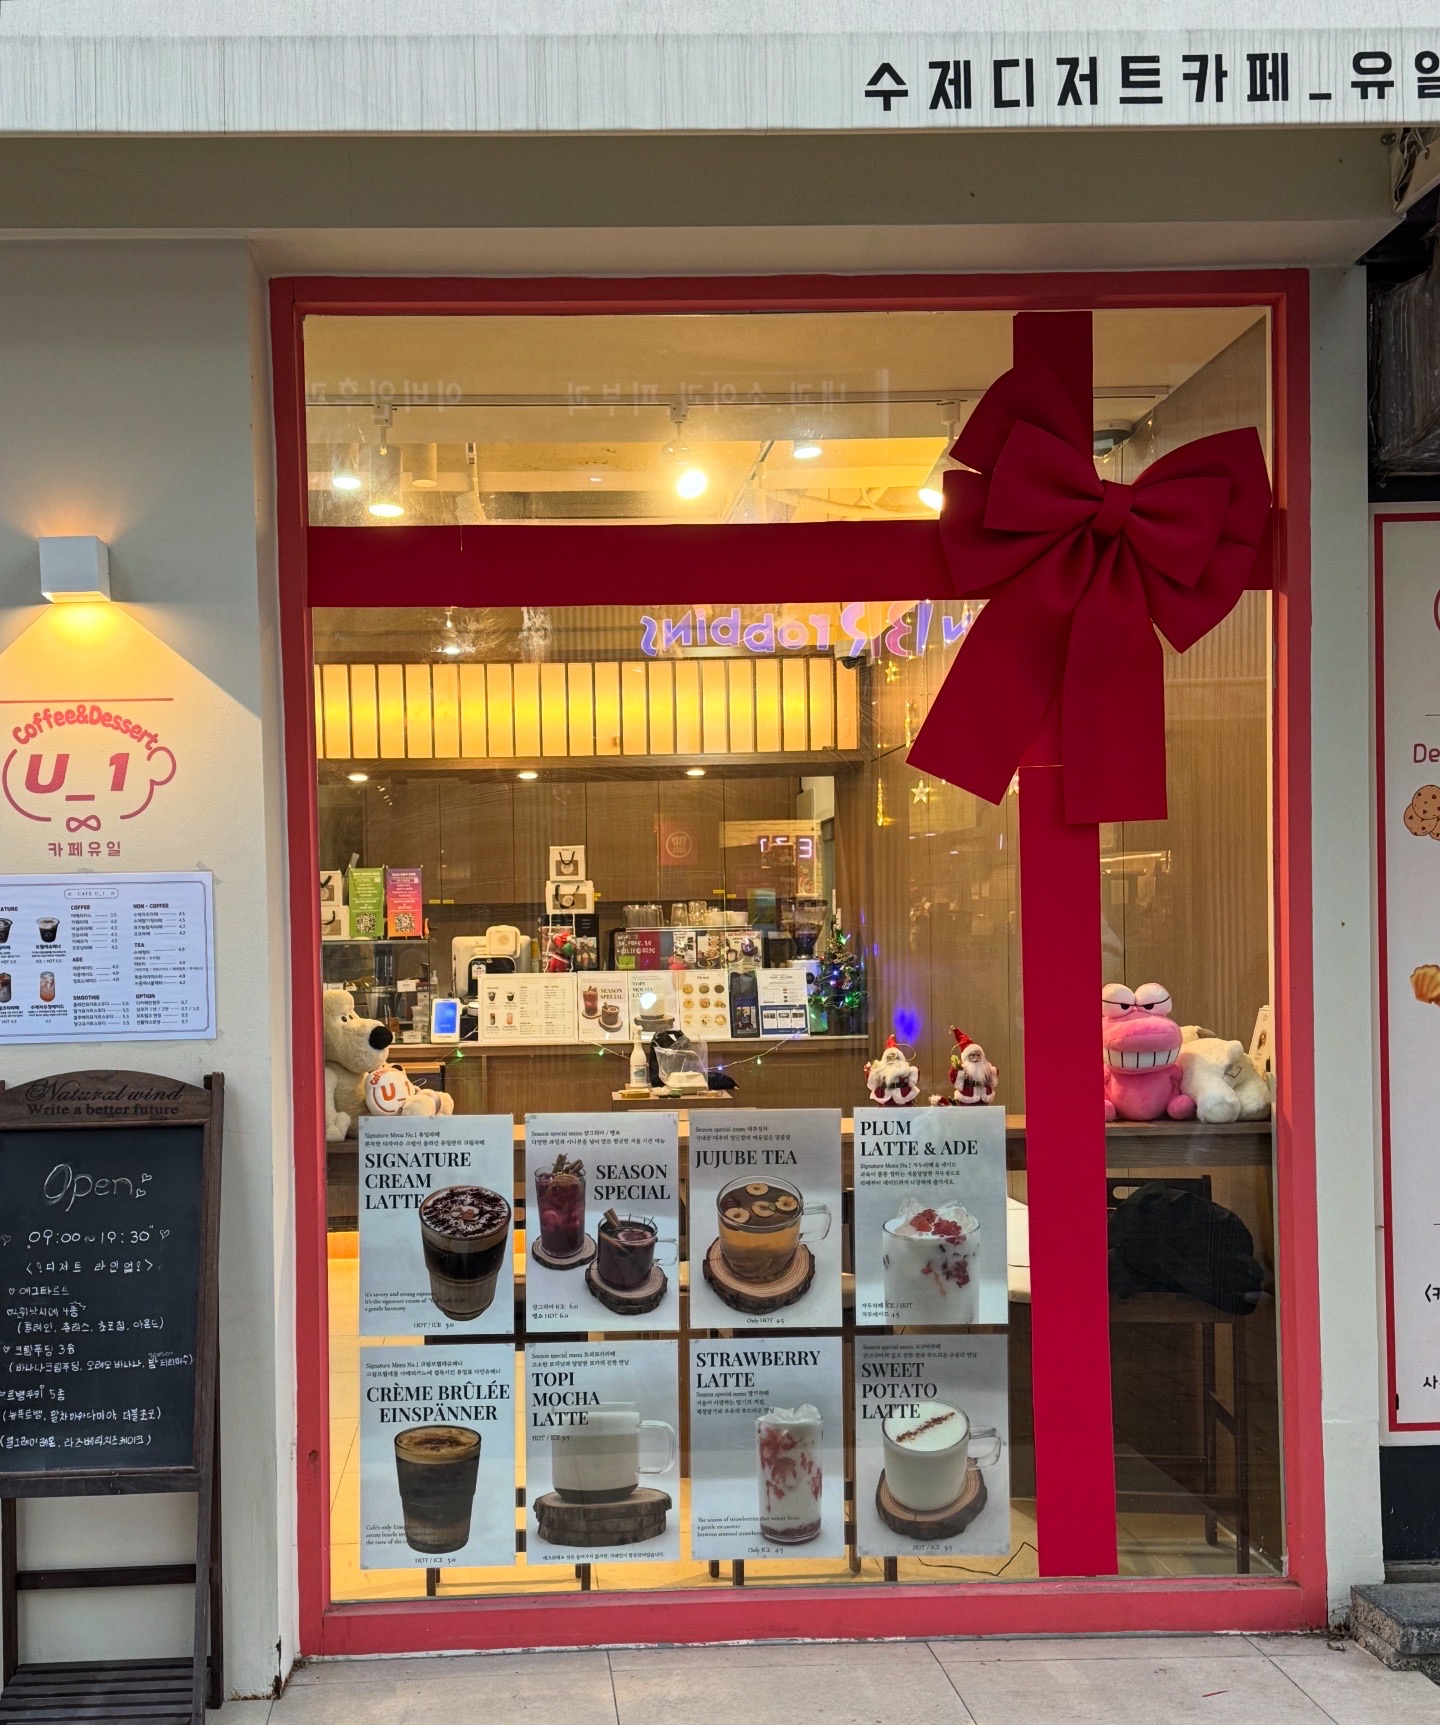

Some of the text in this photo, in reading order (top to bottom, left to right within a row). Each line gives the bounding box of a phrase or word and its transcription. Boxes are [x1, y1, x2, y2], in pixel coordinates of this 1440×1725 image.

[48, 841, 121, 858] 카페유일
[26, 1078, 187, 1101] Natural wind
[27, 1104, 179, 1115] Write a better future
[860, 1121, 911, 1136] PLUM
[860, 1140, 978, 1156] LATTE & ADE
[365, 1152, 471, 1168] SIGNATURE
[695, 1150, 798, 1169] JUJUBE TEA
[596, 1165, 668, 1180] SEASON
[44, 1164, 133, 1211] Open
[365, 1174, 431, 1189] CREAM
[594, 1186, 670, 1200] SPECIAL
[19, 1286, 70, 1295] 에그타르트
[15, 1344, 75, 1357] 크림푸딩 3종
[696, 1351, 821, 1367] STRAWBERRY
[862, 1363, 924, 1378] SWEET
[532, 1372, 575, 1387] TOPI
[697, 1372, 755, 1389] LATTE
[366, 1380, 510, 1403] CRÈME BRÛLÉE
[862, 1383, 937, 1399] POTATO
[533, 1392, 601, 1407] MOCHA
[380, 1403, 498, 1423] EINSPÄNNER
[533, 1411, 589, 1427] LATTE
[862, 1404, 920, 1419] LATTE
